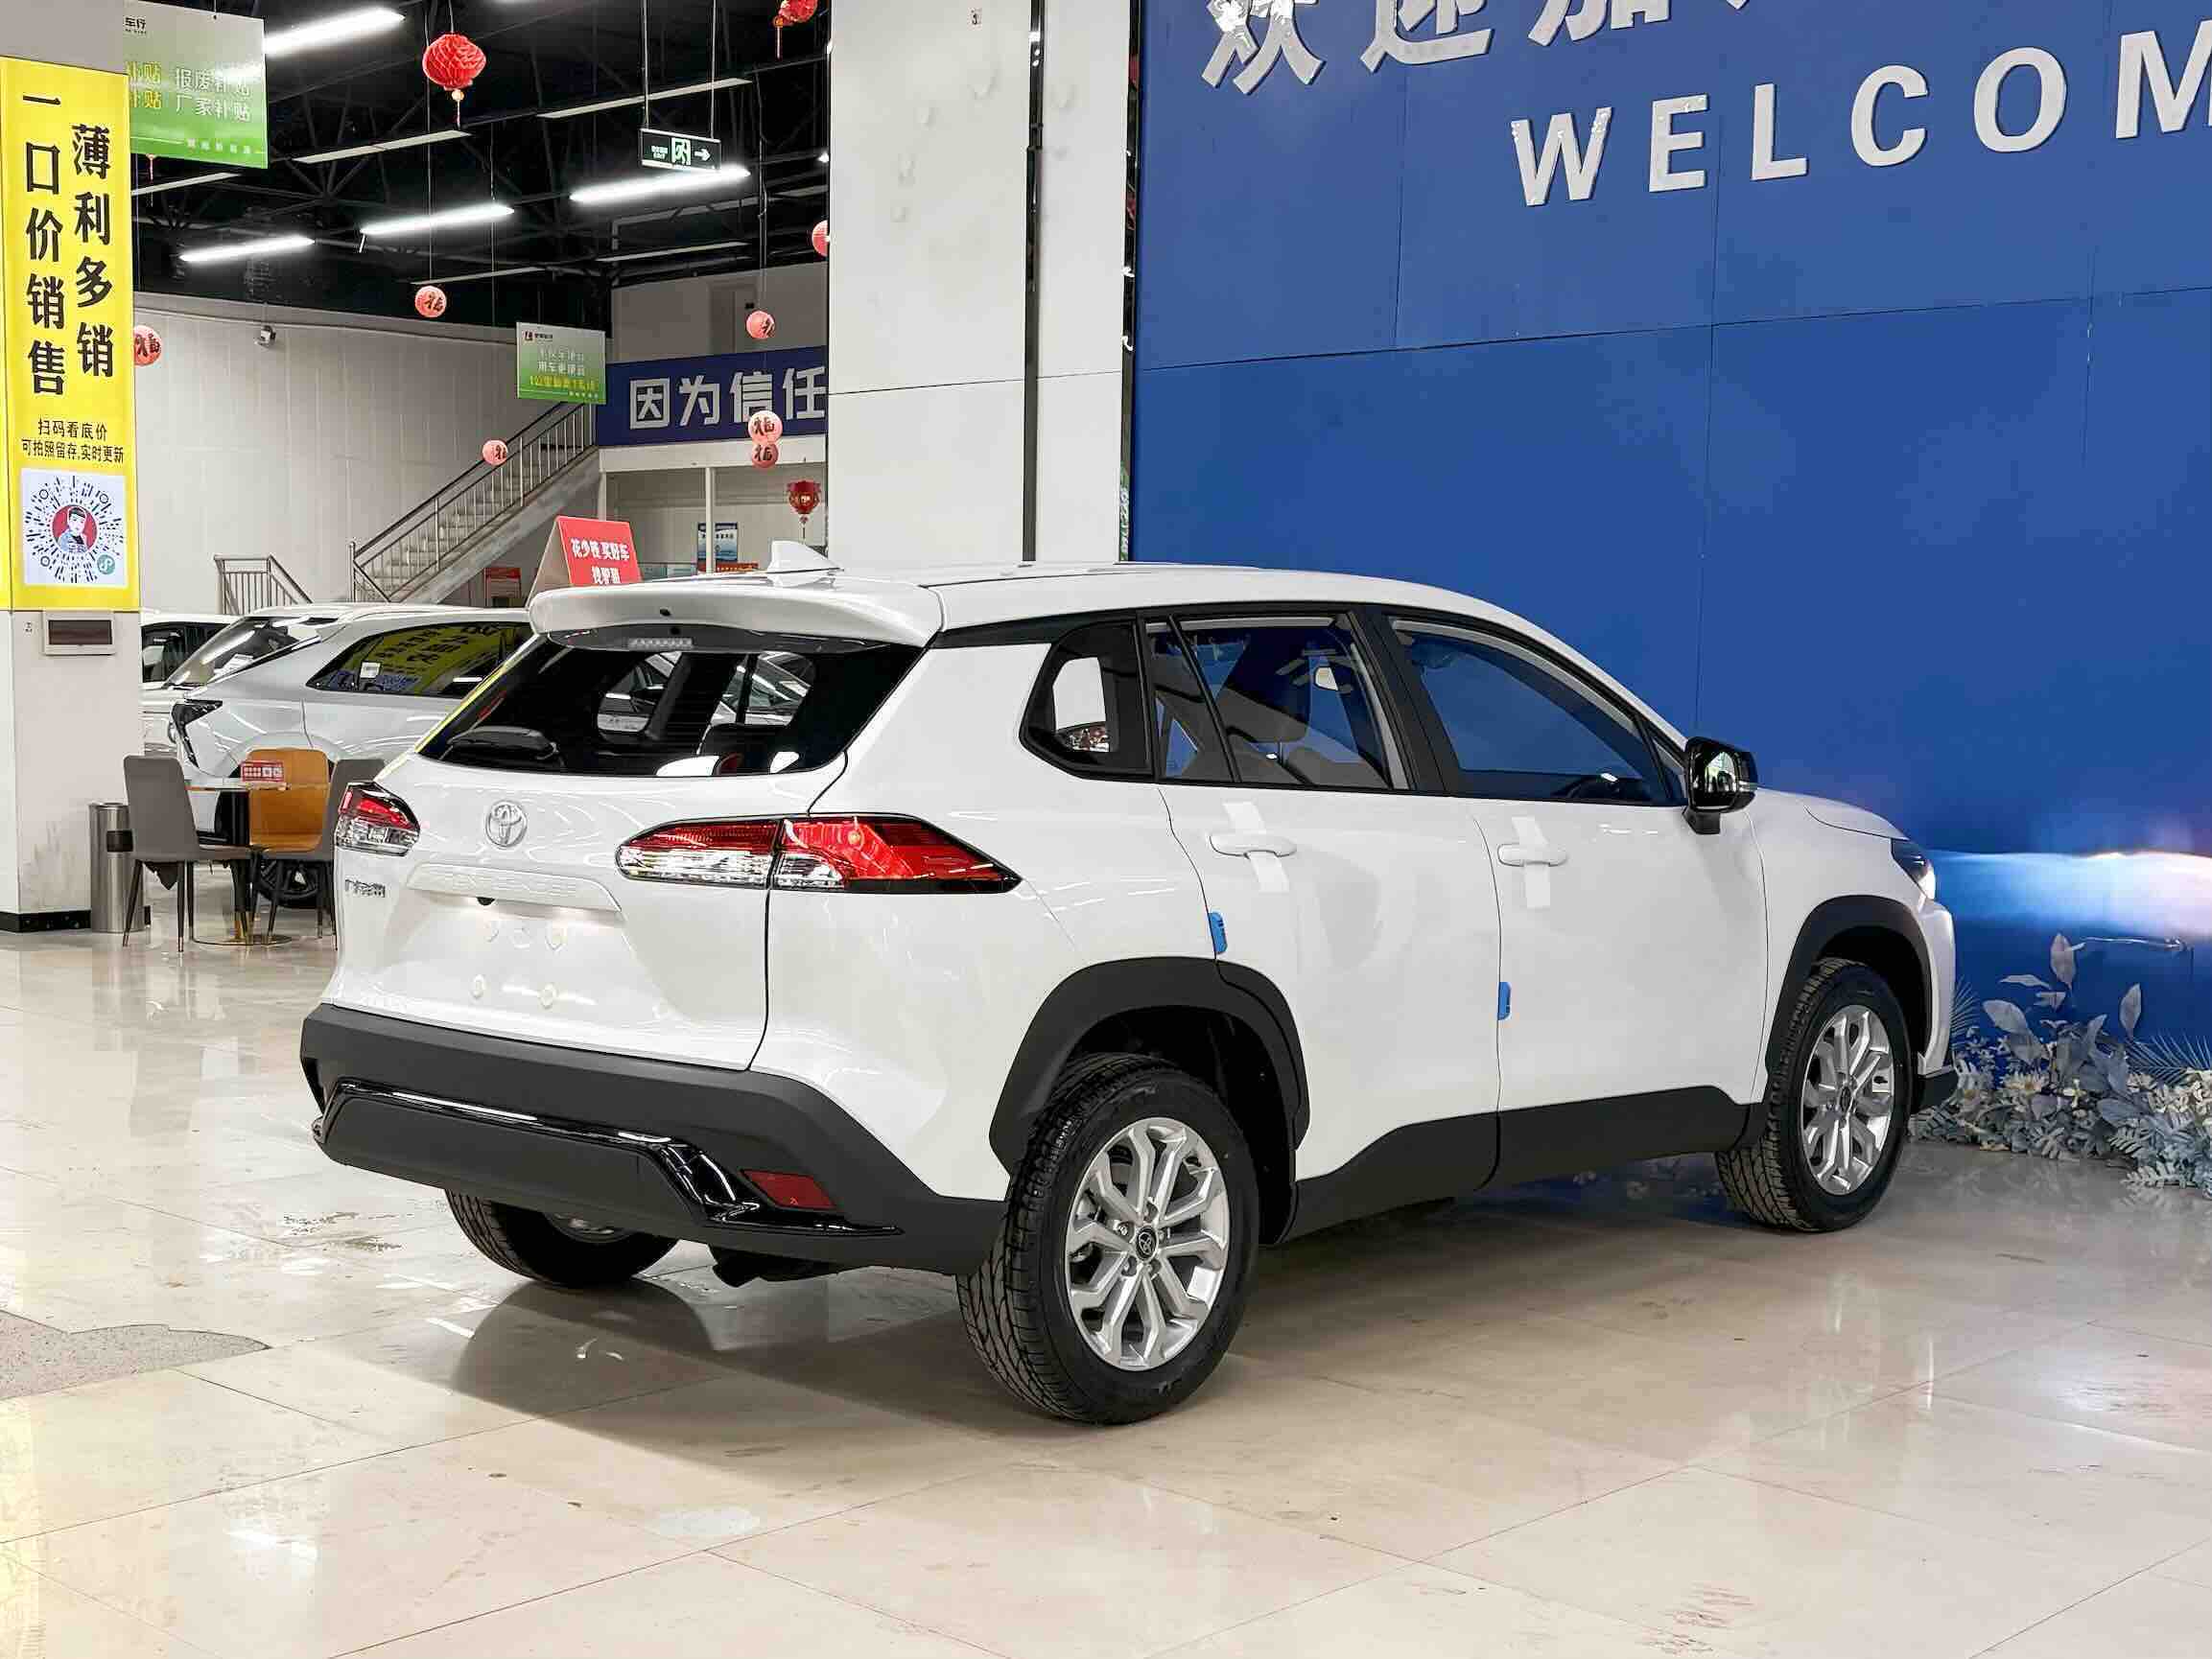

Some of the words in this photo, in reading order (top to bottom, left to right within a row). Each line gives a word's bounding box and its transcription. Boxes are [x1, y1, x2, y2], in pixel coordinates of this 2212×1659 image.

[176, 92, 250, 122] 厂家补贴
[1511, 19, 2212, 206] WELCOM
[22, 93, 64, 395] 一口价销售
[72, 123, 113, 378] 薄利多销
[37, 417, 107, 441] 扫码看底价
[629, 365, 826, 430] 因为信任
